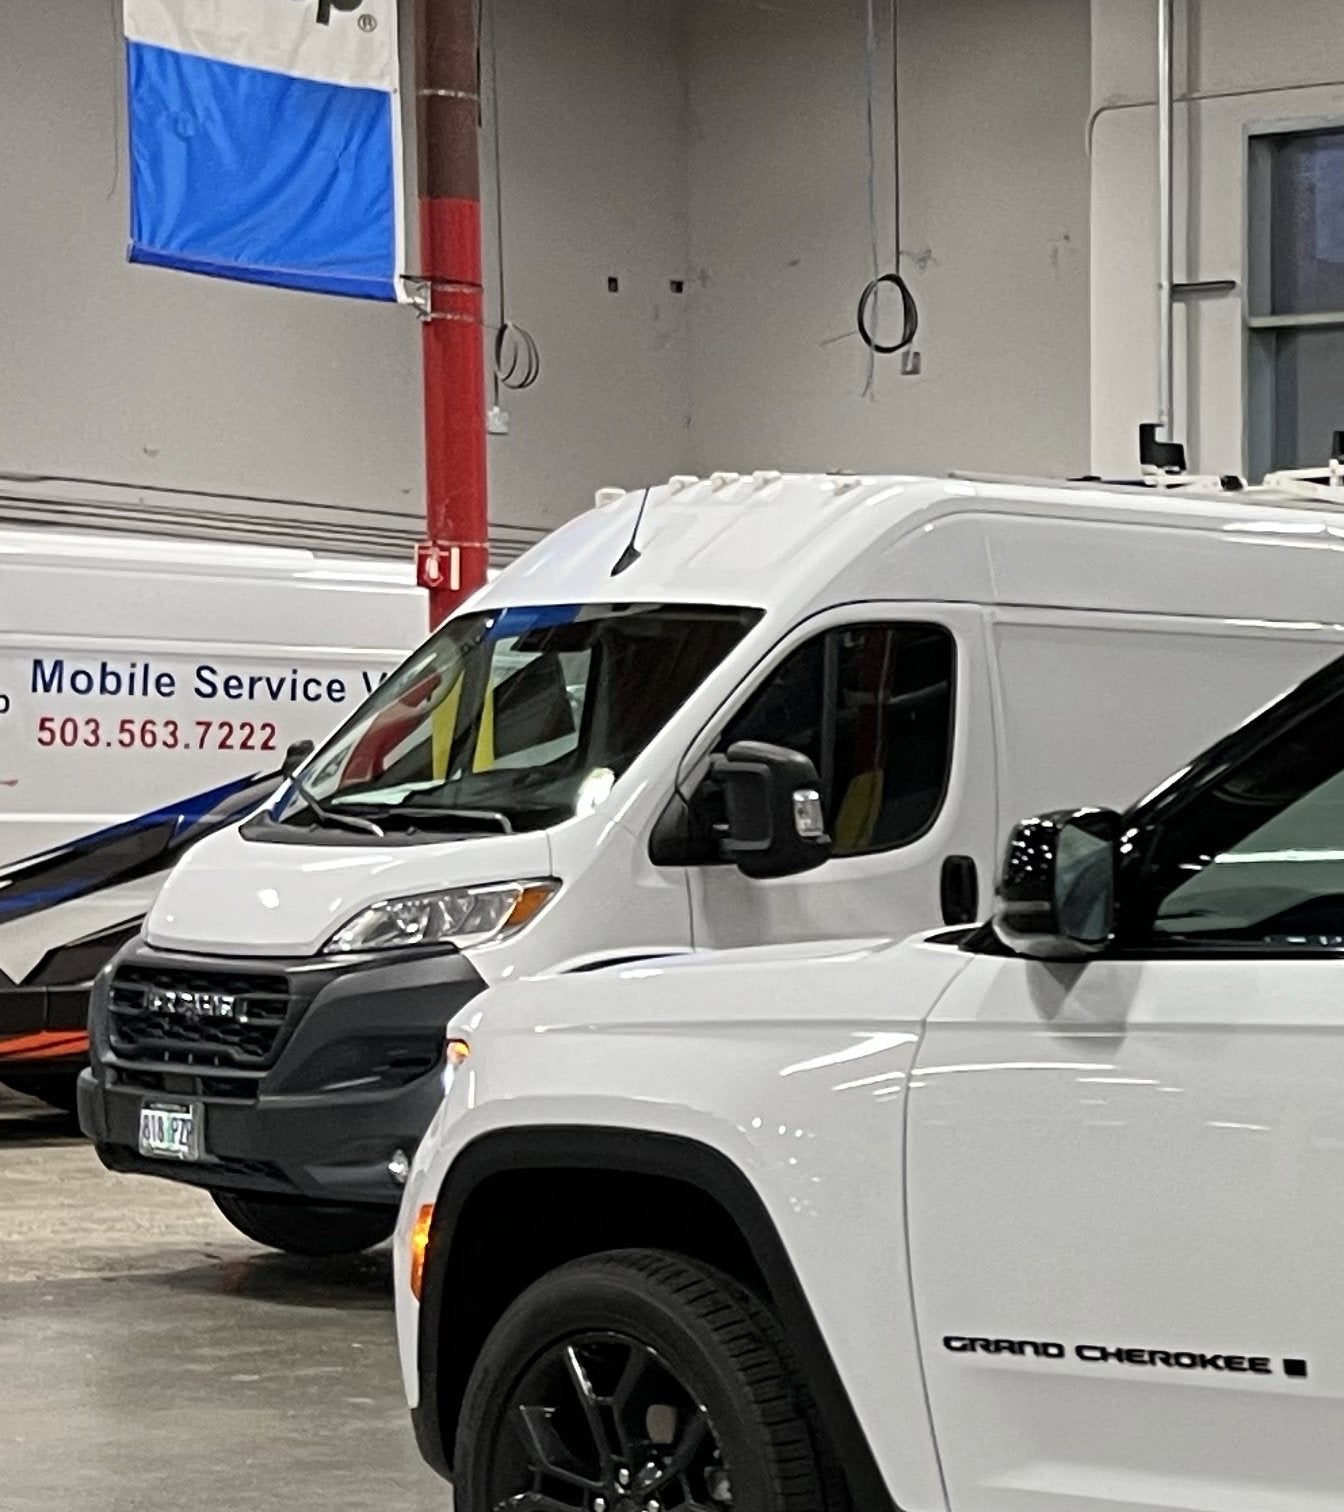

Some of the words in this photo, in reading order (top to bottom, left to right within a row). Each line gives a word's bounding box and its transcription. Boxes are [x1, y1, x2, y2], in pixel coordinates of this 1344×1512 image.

[31, 658, 177, 698] Mobile
[193, 664, 347, 703] Service
[36, 716, 278, 751] 503.563.7222
[942, 1335, 1066, 1359] GRAND
[1074, 1344, 1273, 1374] CHEROKEE
